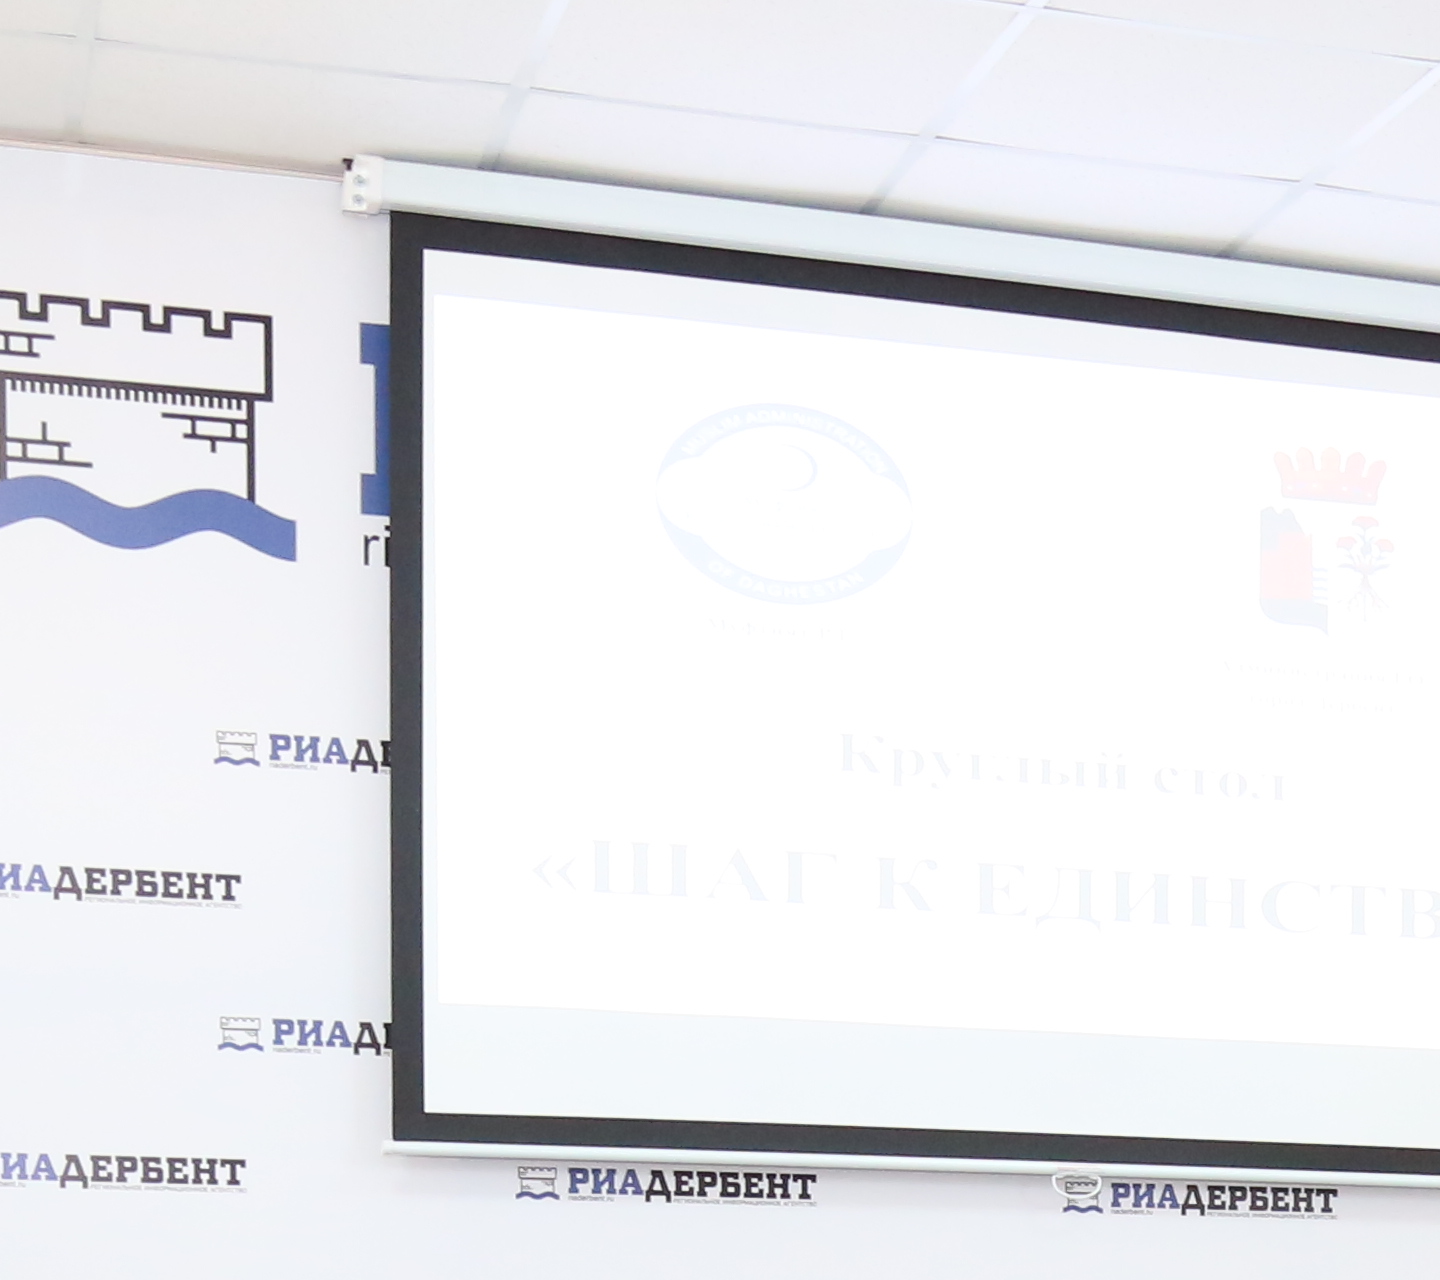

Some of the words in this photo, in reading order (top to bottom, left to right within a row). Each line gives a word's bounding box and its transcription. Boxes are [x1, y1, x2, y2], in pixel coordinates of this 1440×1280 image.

[837, 731, 1131, 797] Круглый
[1154, 765, 1286, 804] стол
[530, 838, 837, 904] «ШАГ
[874, 857, 941, 917] К
[568, 1167, 817, 1203] РИАДЕРБЕНТ
[1110, 1182, 1339, 1217] РИАДЕРБЕНТ
